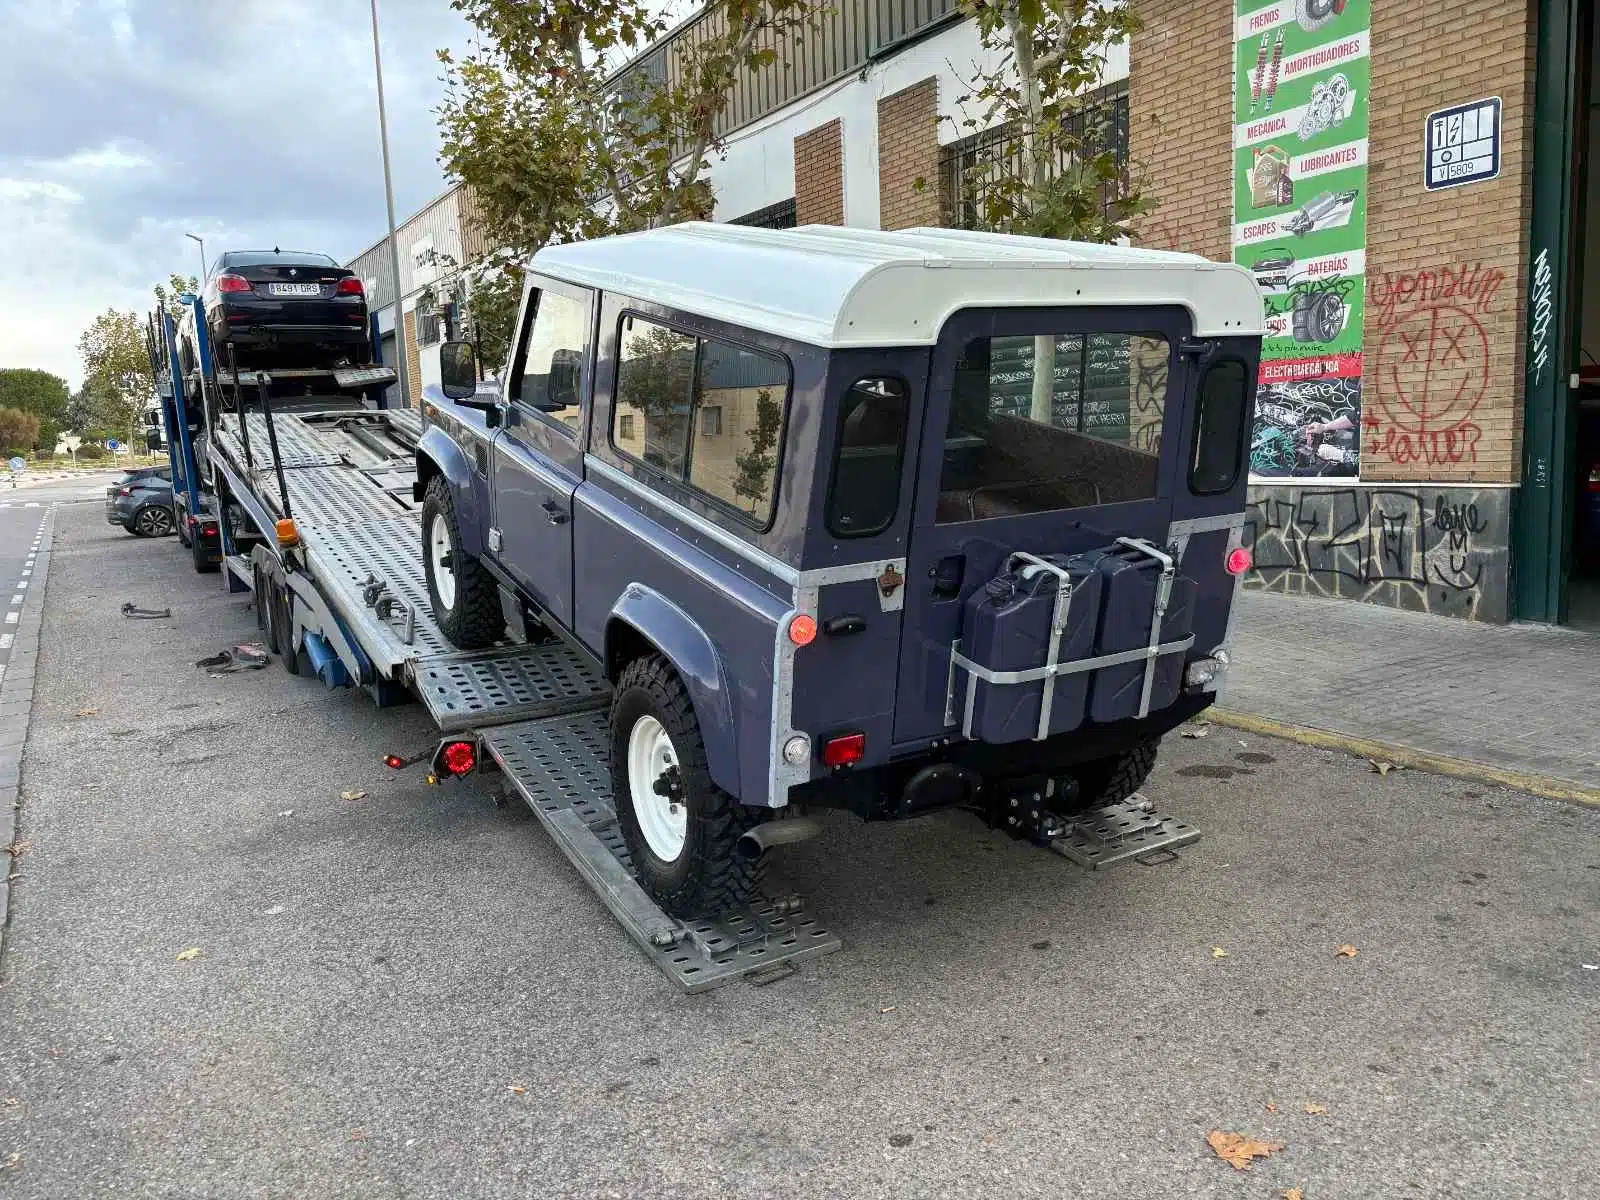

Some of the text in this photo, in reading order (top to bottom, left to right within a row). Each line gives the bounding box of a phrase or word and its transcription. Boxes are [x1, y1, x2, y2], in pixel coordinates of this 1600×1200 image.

[1250, 8, 1280, 30] FRENOS
[1284, 39, 1361, 75] AMORTIGUADORES
[1247, 114, 1287, 140] MECÁNICA
[1300, 147, 1358, 173] LUBRICANTES
[1450, 161, 1474, 177] 5809
[1243, 221, 1277, 239] ESCAPES
[1308, 257, 1348, 276] BATERÍAS
[276, 284, 298, 293] 8491
